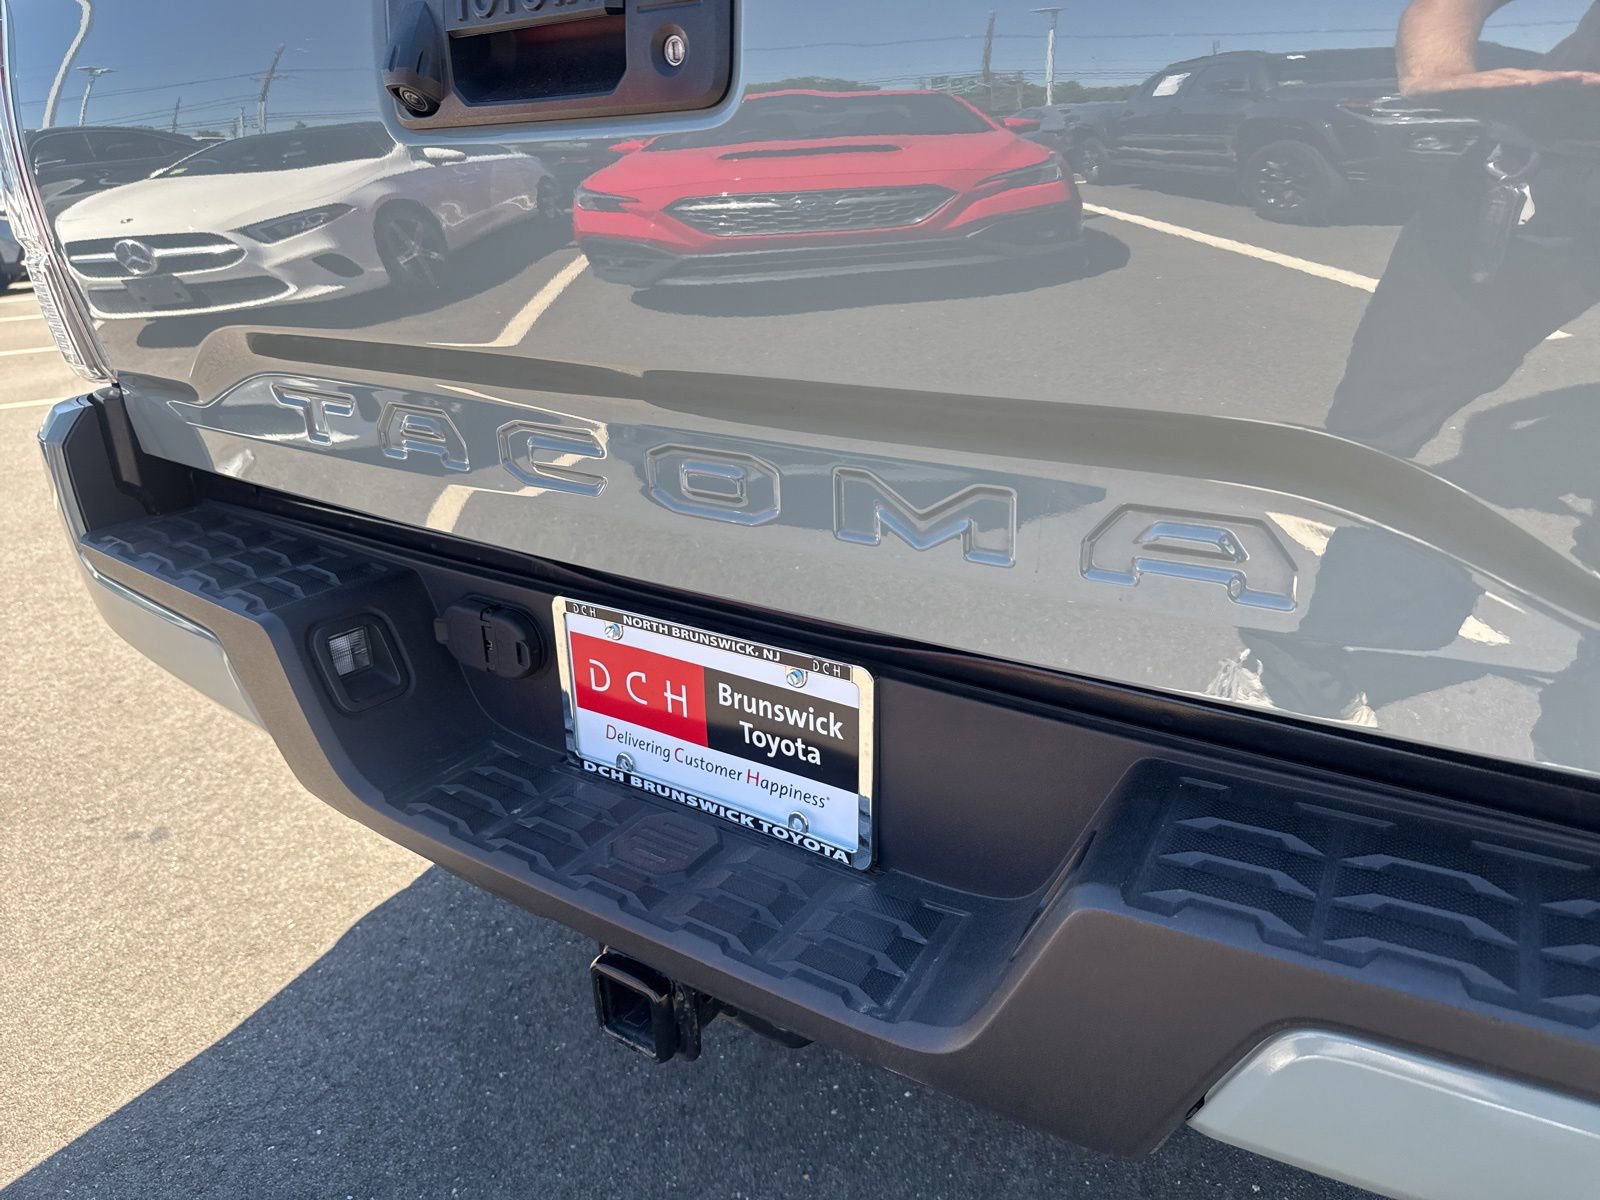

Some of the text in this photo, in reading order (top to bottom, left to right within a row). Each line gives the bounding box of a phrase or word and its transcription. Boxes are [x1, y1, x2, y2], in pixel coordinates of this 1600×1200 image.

[271, 382, 1298, 612] TACOMA
[573, 603, 597, 617] DCH
[623, 615, 781, 662] NORTH BRUNSWICK, NJ
[589, 658, 688, 718] DCH
[812, 660, 841, 677] DCH
[718, 682, 844, 740] Brunswick
[606, 724, 826, 809] Delivering Customer Happiness
[739, 721, 821, 765] Toyota
[583, 760, 850, 864] DCH BRUNSWICK TOYOTA
